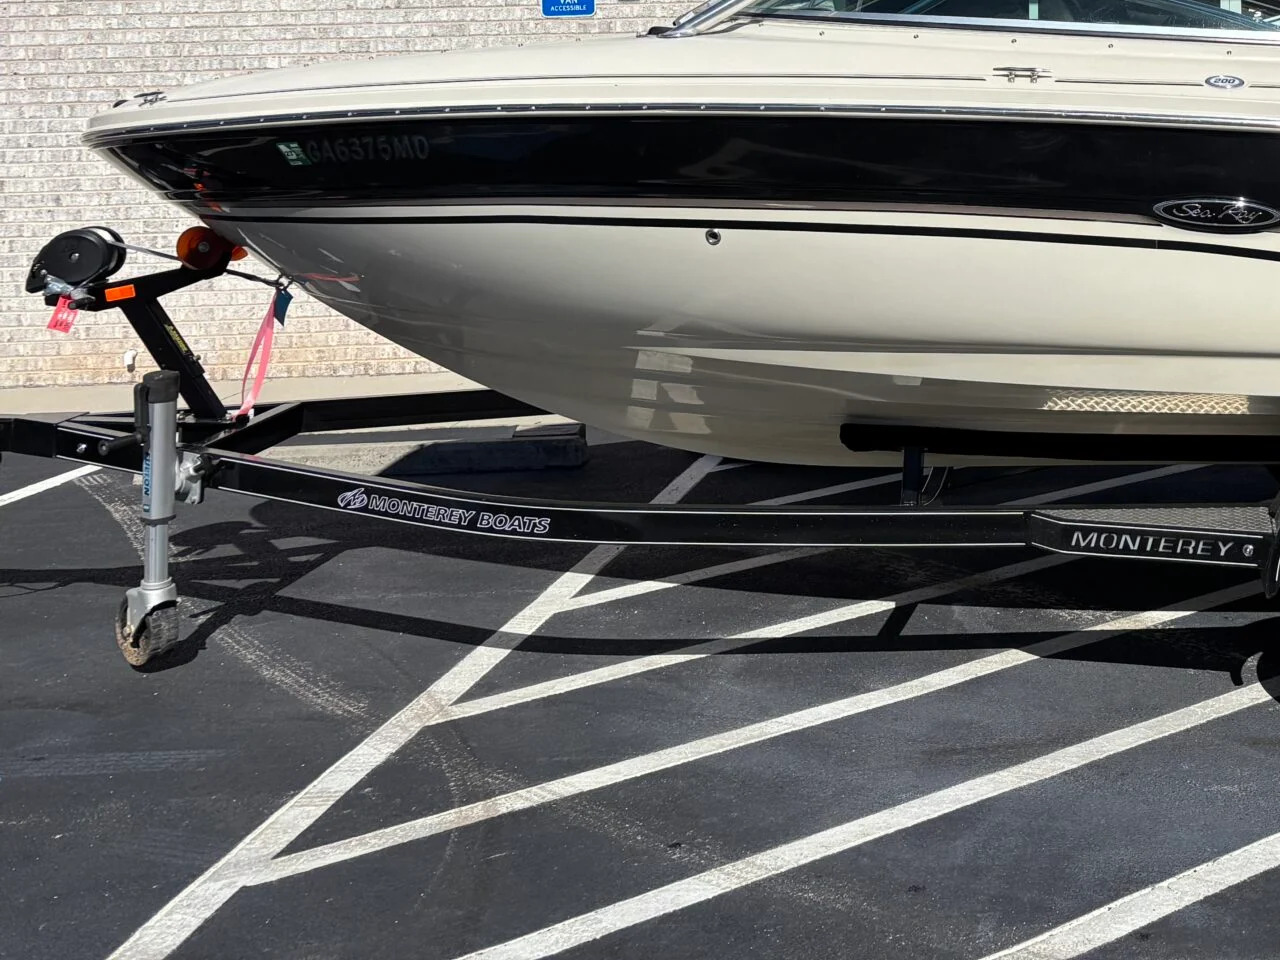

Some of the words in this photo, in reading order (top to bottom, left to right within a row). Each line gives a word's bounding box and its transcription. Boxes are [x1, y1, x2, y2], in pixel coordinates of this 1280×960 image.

[550, 4, 588, 12] ACCESSIBLE
[1173, 203, 1216, 218] Sea
[1217, 204, 1262, 225] Ray
[368, 494, 475, 526] MONTEREY
[477, 512, 551, 534] BOATS
[1070, 531, 1235, 557] MONTEREY
